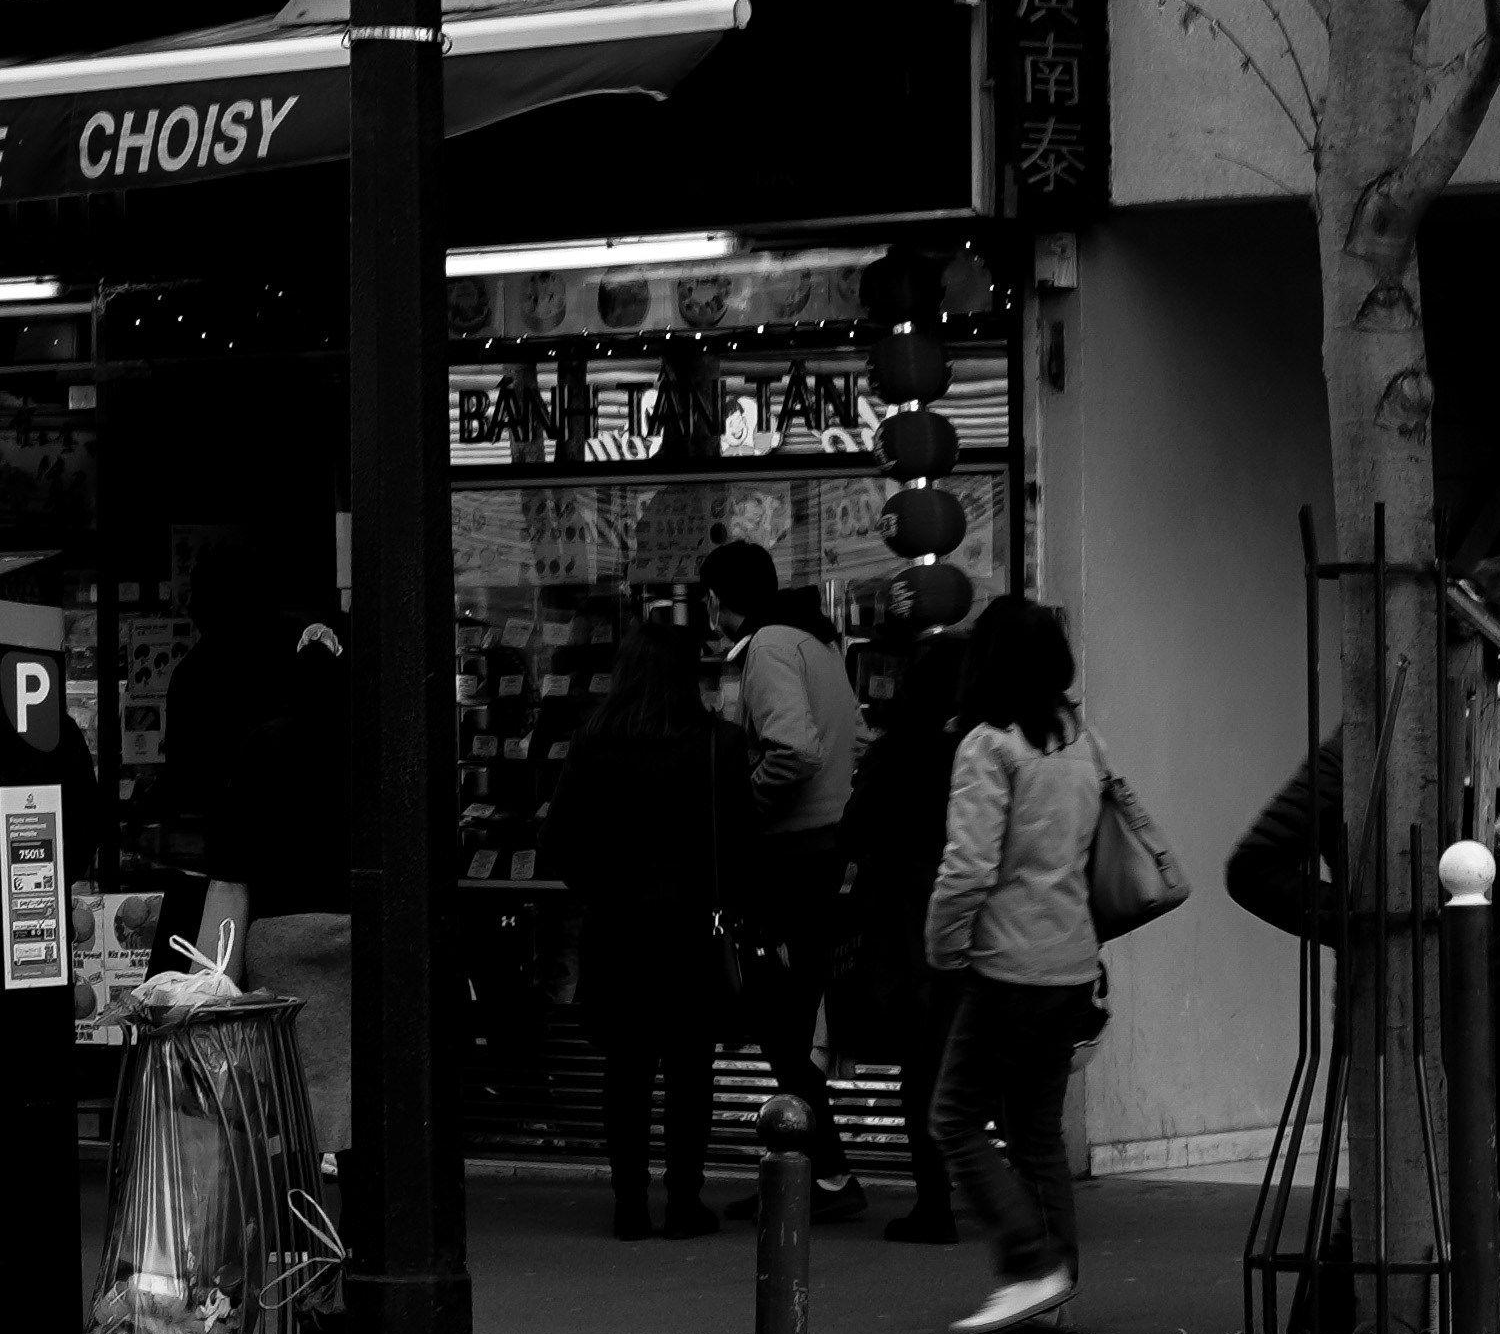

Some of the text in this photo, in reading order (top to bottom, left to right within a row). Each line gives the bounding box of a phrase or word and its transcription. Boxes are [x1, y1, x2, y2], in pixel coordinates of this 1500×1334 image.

[78, 94, 300, 180] CHOISY
[15, 660, 51, 734] P
[18, 848, 46, 860] 75013
